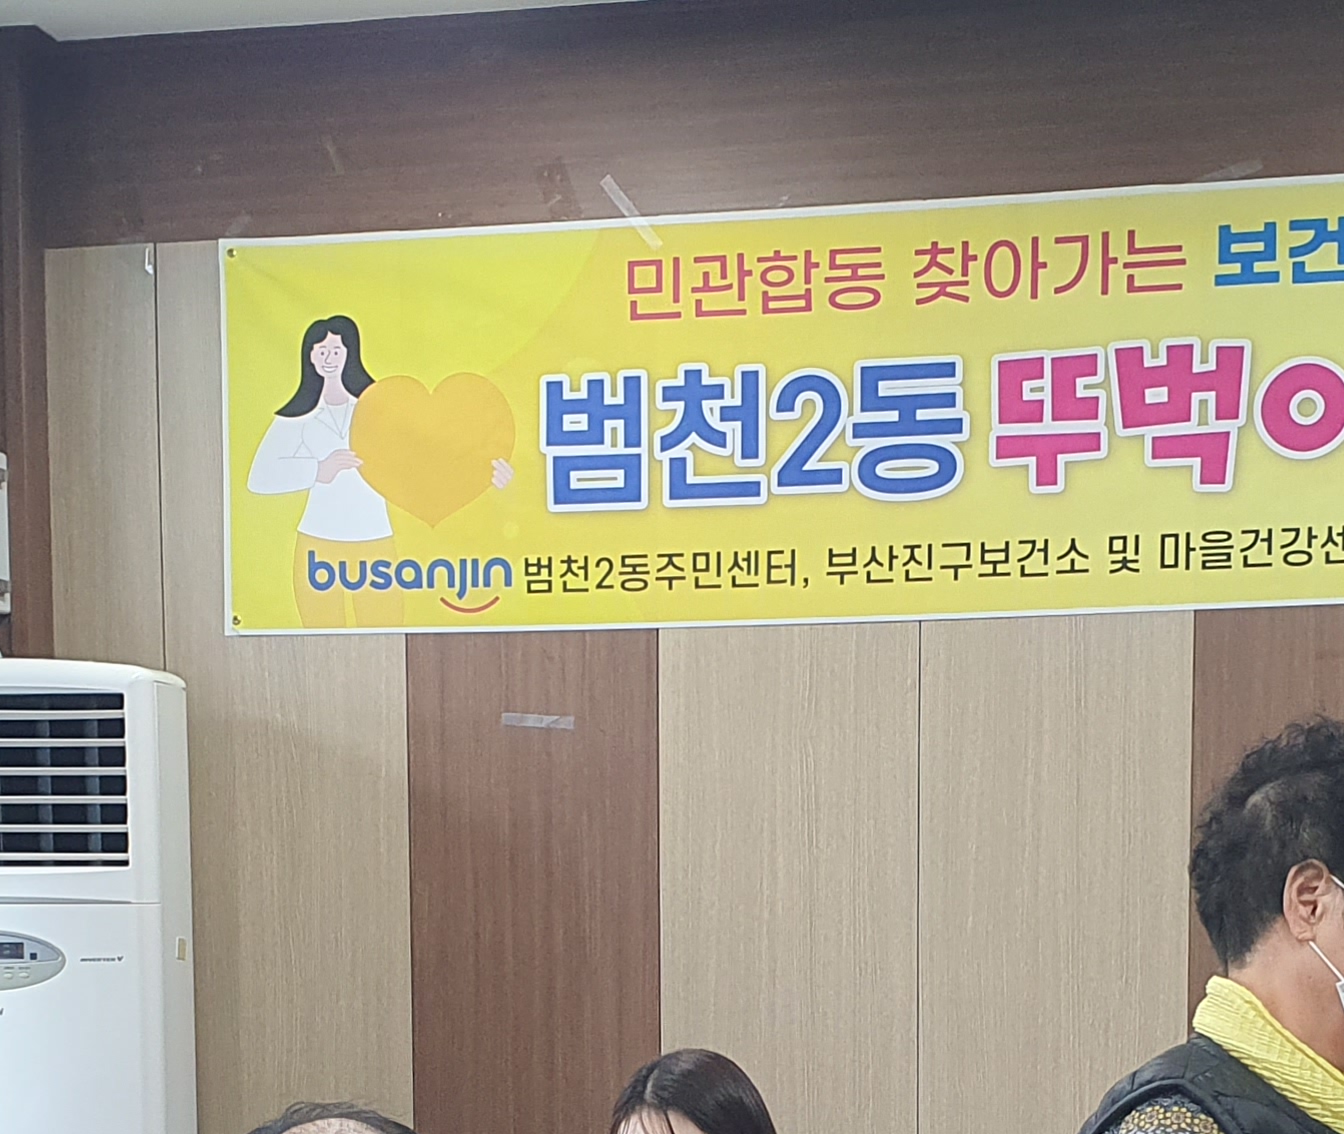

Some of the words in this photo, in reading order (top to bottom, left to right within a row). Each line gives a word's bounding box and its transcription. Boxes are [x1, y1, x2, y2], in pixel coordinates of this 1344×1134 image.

[626, 245, 887, 322] 민관합동
[913, 228, 1188, 306] 찾아가는
[544, 360, 966, 507] 범천2동
[307, 549, 514, 601] busanjin
[523, 546, 812, 596] 범천2동주민센터,
[824, 539, 1091, 587] 부산진구보건소
[1106, 533, 1143, 576] 및
